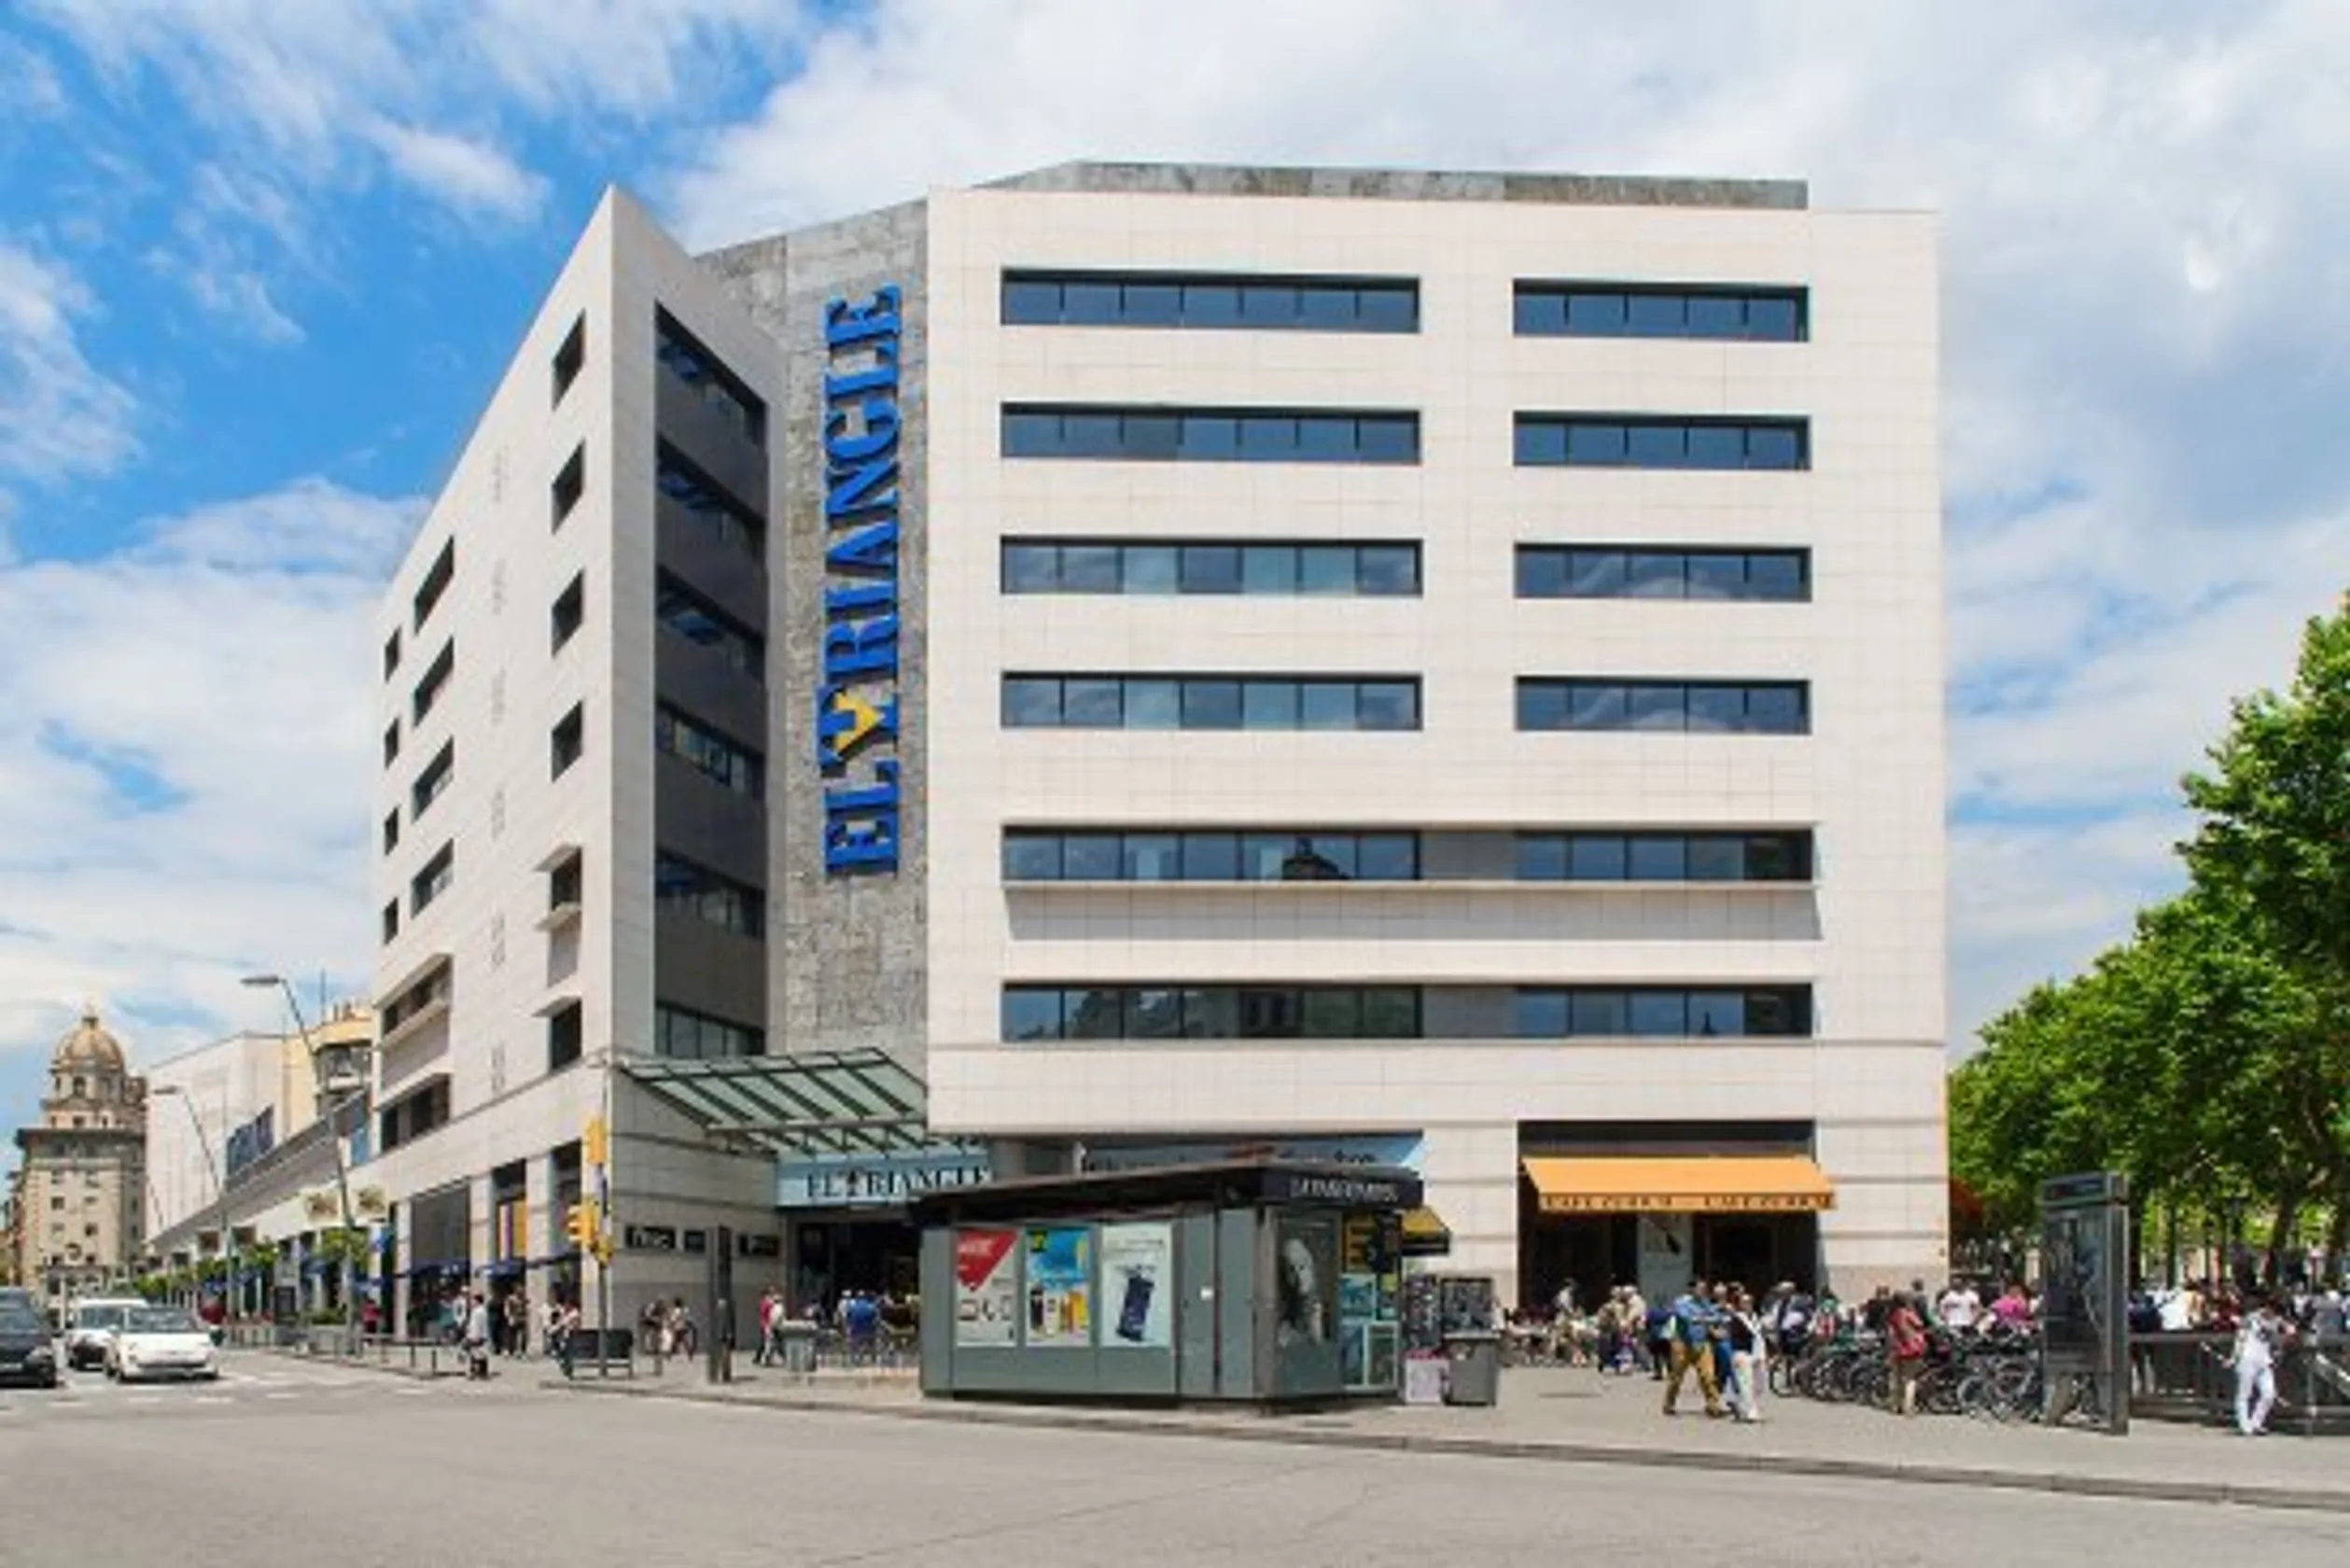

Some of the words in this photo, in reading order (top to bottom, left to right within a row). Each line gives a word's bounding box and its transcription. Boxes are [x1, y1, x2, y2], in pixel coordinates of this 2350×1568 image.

[817, 283, 902, 770] TRIANGLE
[823, 759, 900, 876] EL
[806, 1171, 839, 1198] EL
